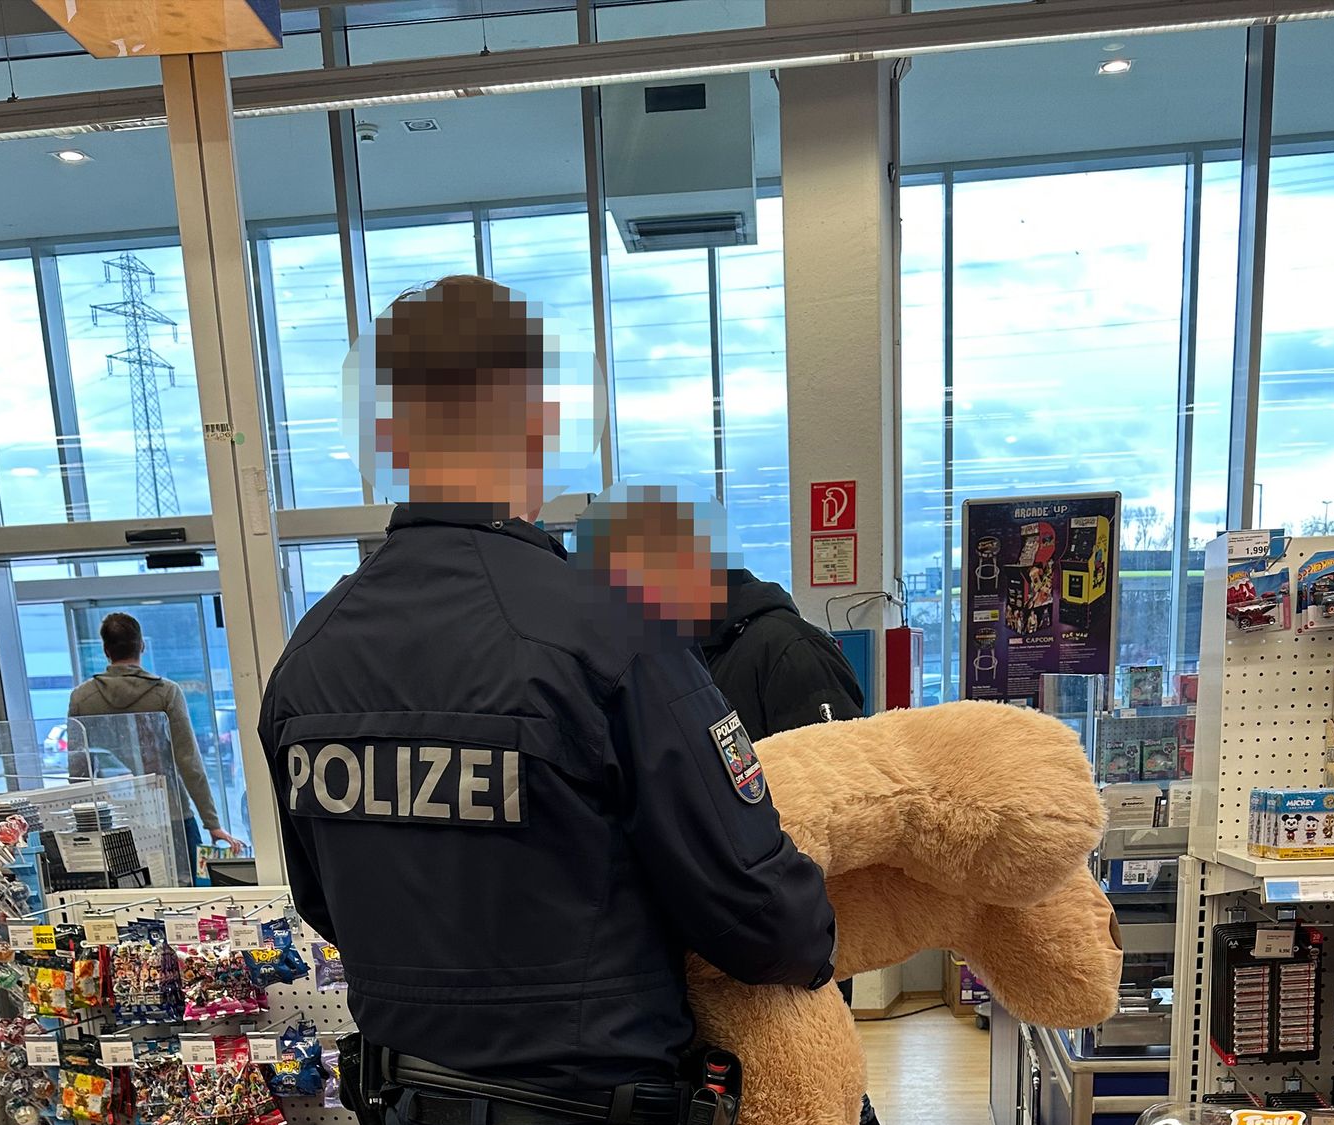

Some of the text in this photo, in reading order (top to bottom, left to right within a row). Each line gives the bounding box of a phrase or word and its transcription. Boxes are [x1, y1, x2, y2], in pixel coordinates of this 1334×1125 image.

[1014, 506, 1049, 519] ARCADE
[287, 743, 521, 823] POLIZEI
[1286, 799, 1316, 807] MICKEY
